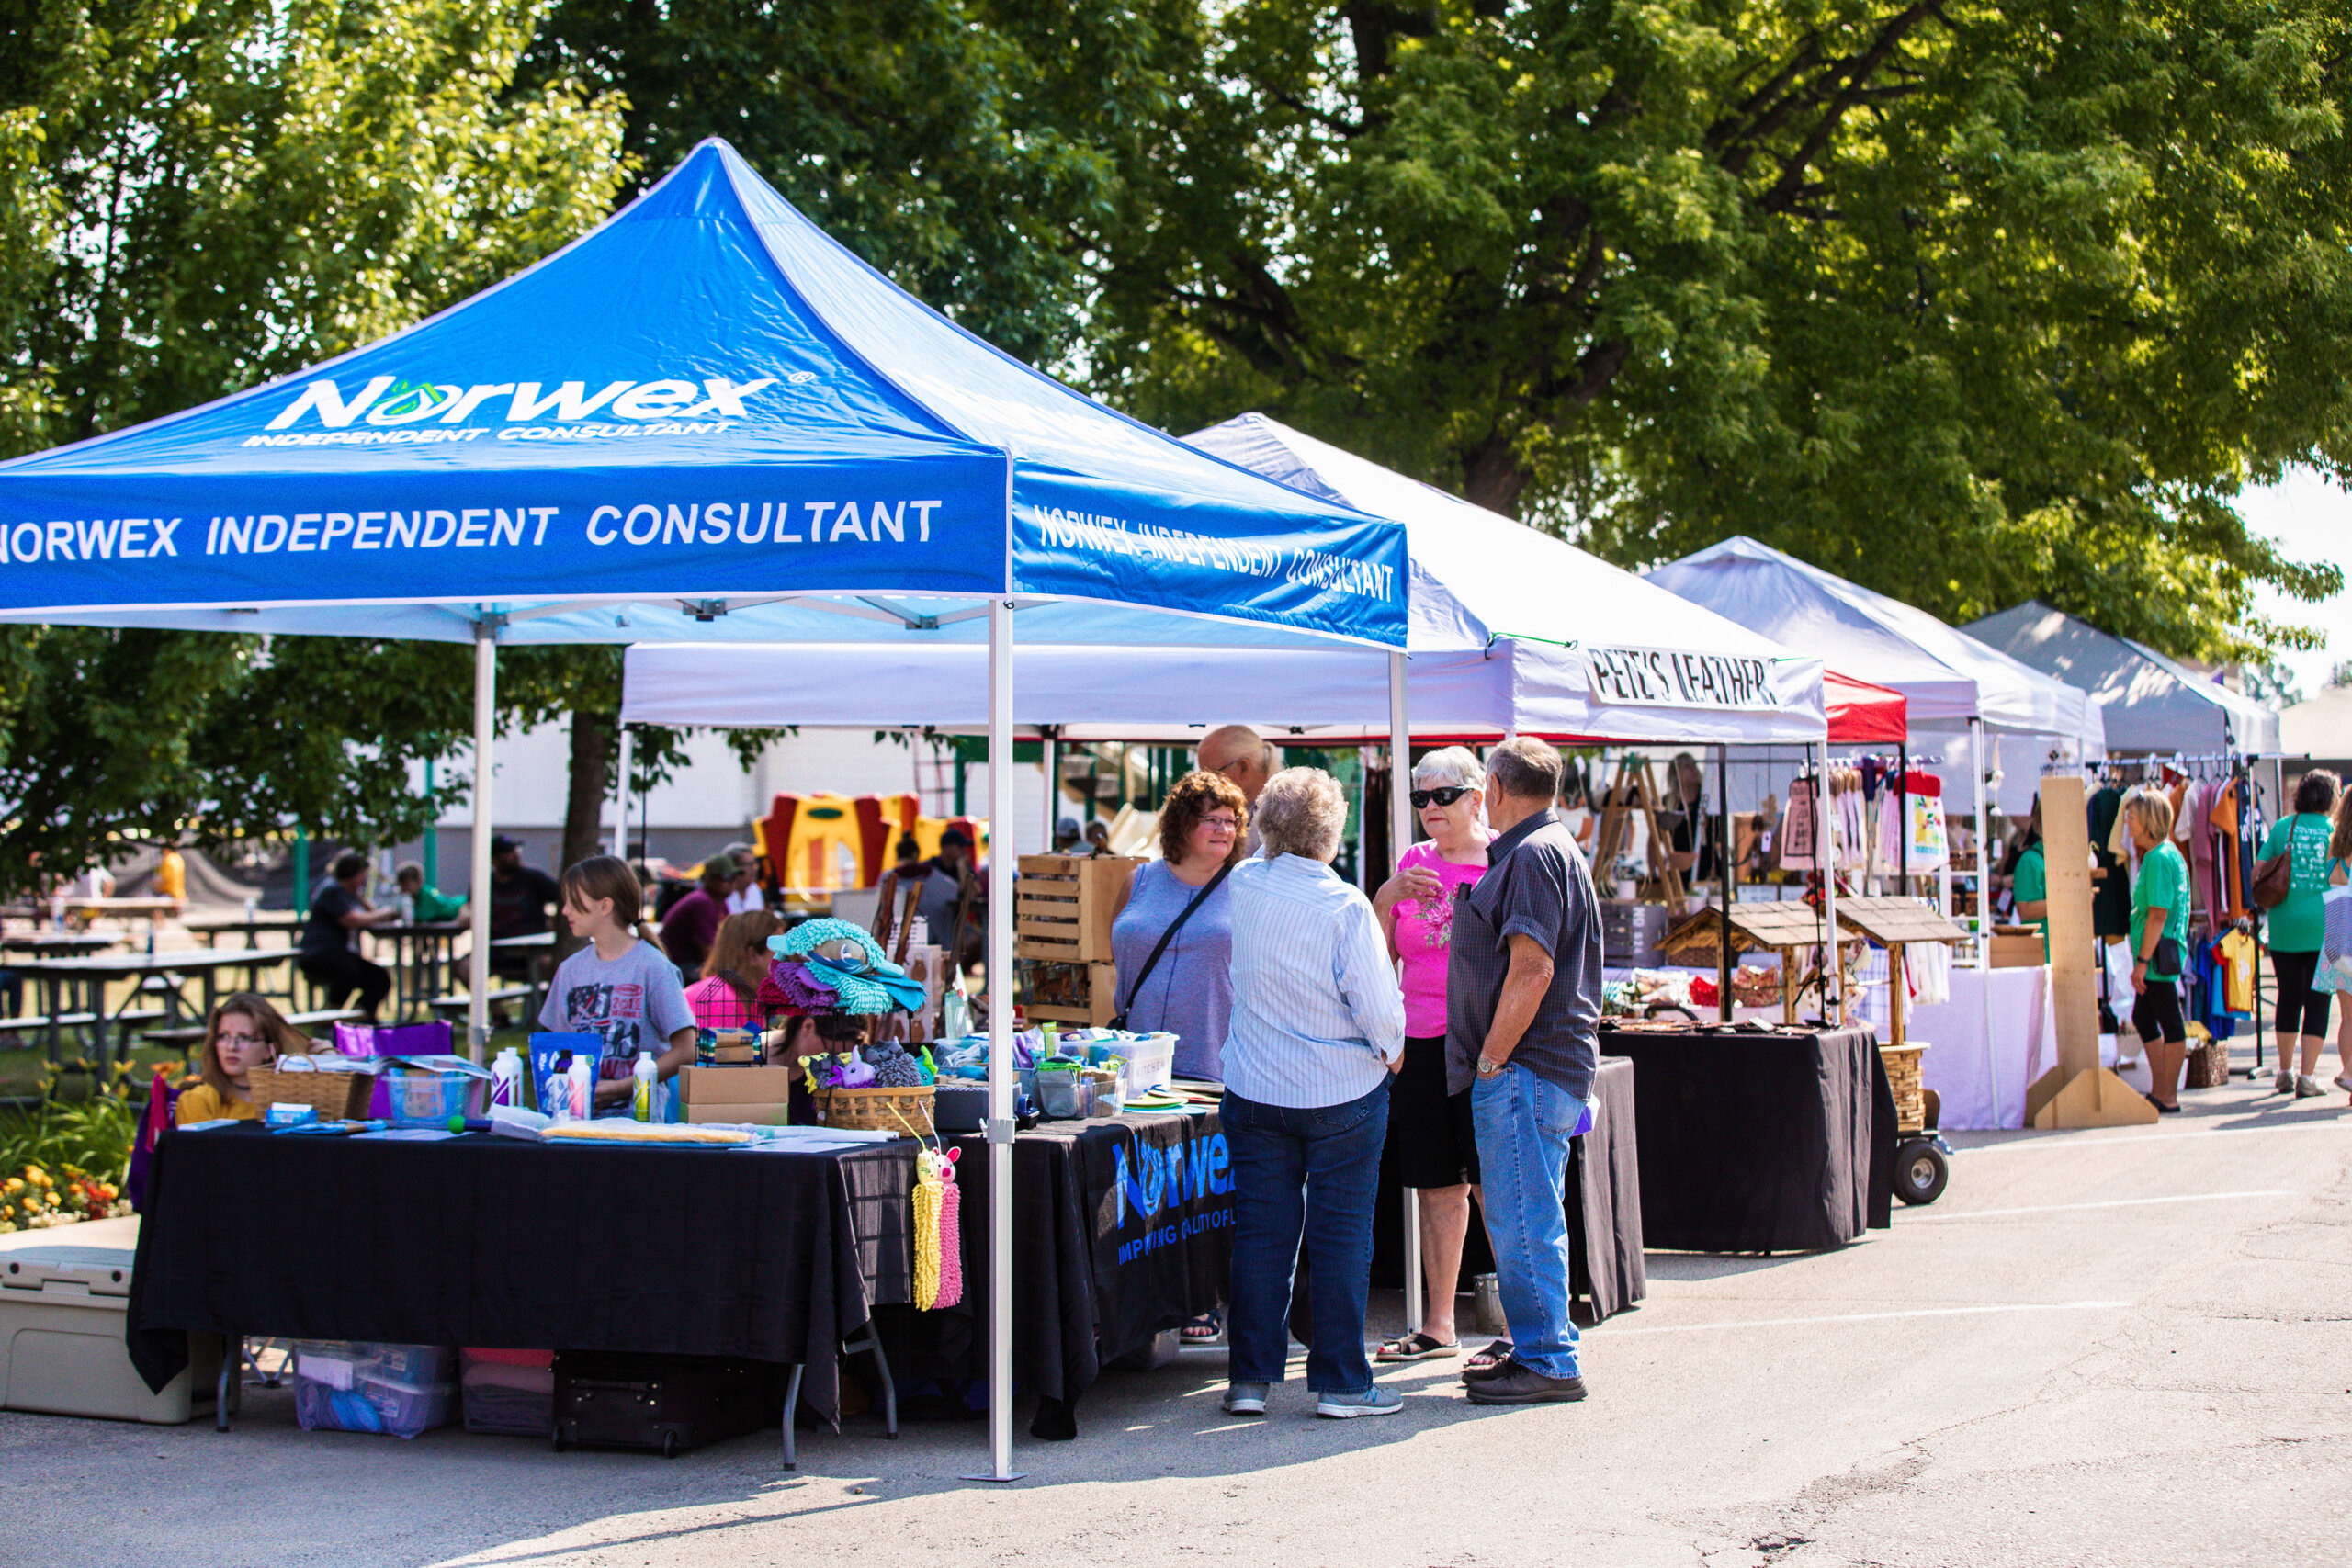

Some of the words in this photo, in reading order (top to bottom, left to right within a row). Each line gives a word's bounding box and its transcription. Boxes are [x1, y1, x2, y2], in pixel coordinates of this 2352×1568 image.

[242, 427, 491, 448] INDEPENDENT
[497, 421, 738, 441] CONSULTANT
[0, 517, 183, 564] ORWEX
[205, 507, 560, 555] INDEPENDENT
[585, 500, 943, 547] CONSULTANT
[1034, 504, 1142, 556] NORWEX
[1138, 522, 1283, 579] INDEPENDENT
[1286, 547, 1395, 604] CONSULTANT
[1587, 647, 1672, 702] PETE'S
[1670, 652, 1779, 705] LEATHER
[1112, 1132, 1237, 1230] Norwe
